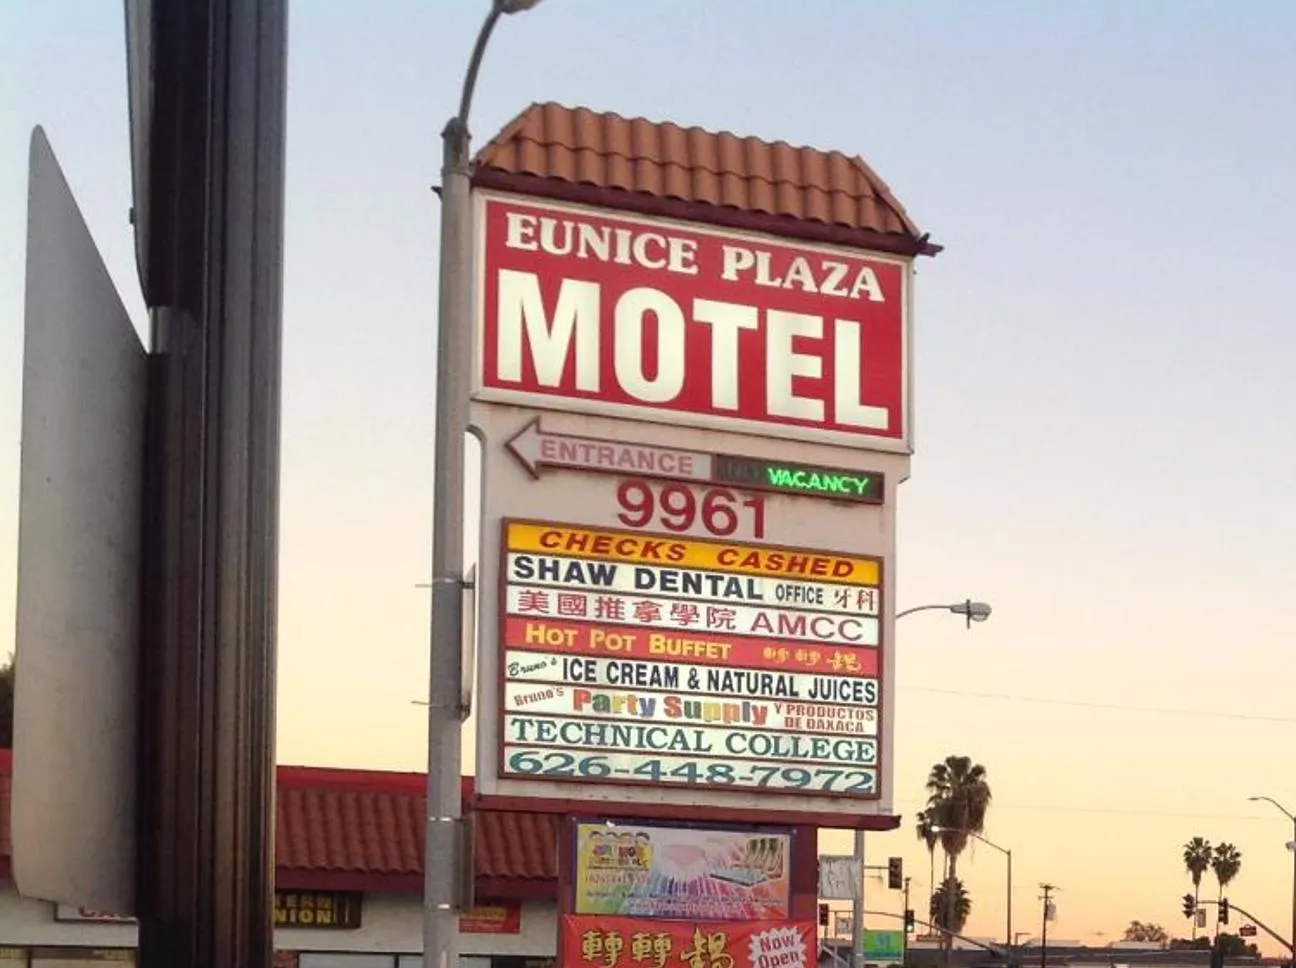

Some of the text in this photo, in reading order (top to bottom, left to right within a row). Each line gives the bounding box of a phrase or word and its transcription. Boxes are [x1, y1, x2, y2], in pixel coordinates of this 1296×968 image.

[505, 212, 886, 302] EUNICE PLAZA
[497, 269, 889, 431] MOTEL
[540, 437, 694, 477] ENTRANCE
[767, 467, 869, 495] VACANCY
[617, 480, 765, 539] 9961
[539, 530, 855, 579] CHECKS CASHED
[513, 555, 824, 606] SHAW DENTAL OFFICE
[833, 589, 875, 612] 牙科
[517, 589, 737, 631] 美國推拿學院
[750, 611, 864, 642] AMCC
[525, 623, 732, 661] HOT POT BUFFET
[507, 657, 876, 704] Bruno's ICE CREAM & NATURAL JUICES
[573, 689, 657, 719] Party
[663, 695, 769, 726] Supply
[773, 702, 783, 715] Y
[786, 704, 875, 722] PRODUCTOS
[784, 716, 865, 733] DE OAXACA
[510, 716, 876, 763] TECHNICAL COLLEGE
[508, 750, 875, 794] 626-448-7972
